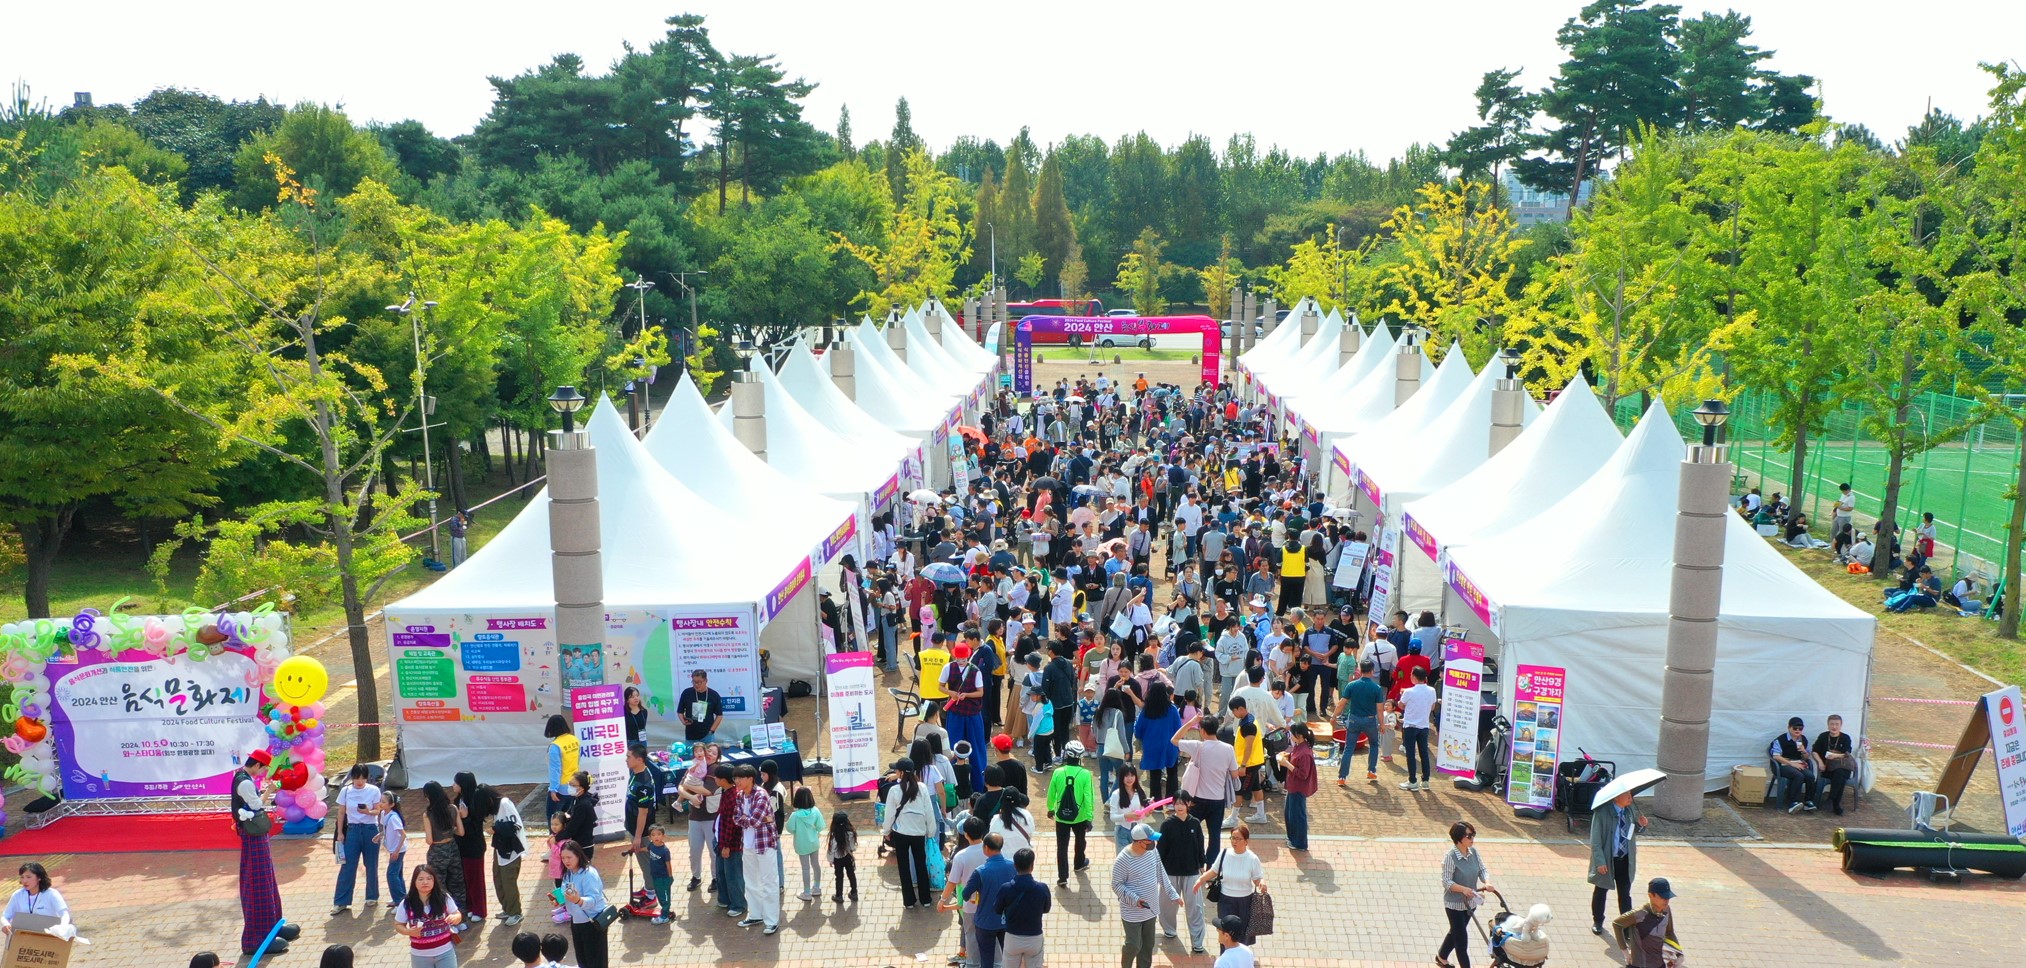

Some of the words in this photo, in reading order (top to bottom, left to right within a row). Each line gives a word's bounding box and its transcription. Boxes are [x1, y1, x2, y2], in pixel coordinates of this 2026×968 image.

[1064, 322, 1092, 333] 2024
[1094, 322, 1114, 333] 안산
[496, 620, 516, 629] 행사장
[676, 619, 704, 628] 행사장내
[705, 618, 733, 627] 안전수칙
[1533, 675, 1562, 687] 안산9경
[71, 696, 98, 707] 2024
[99, 696, 118, 706] 안산
[122, 677, 251, 716] 음식문화제
[1532, 686, 1563, 698] 구경가자
[226, 716, 255, 724] Festival
[580, 723, 620, 741] 대국민
[580, 741, 625, 758] 서명운동
[2005, 740, 2020, 753] 지금은
